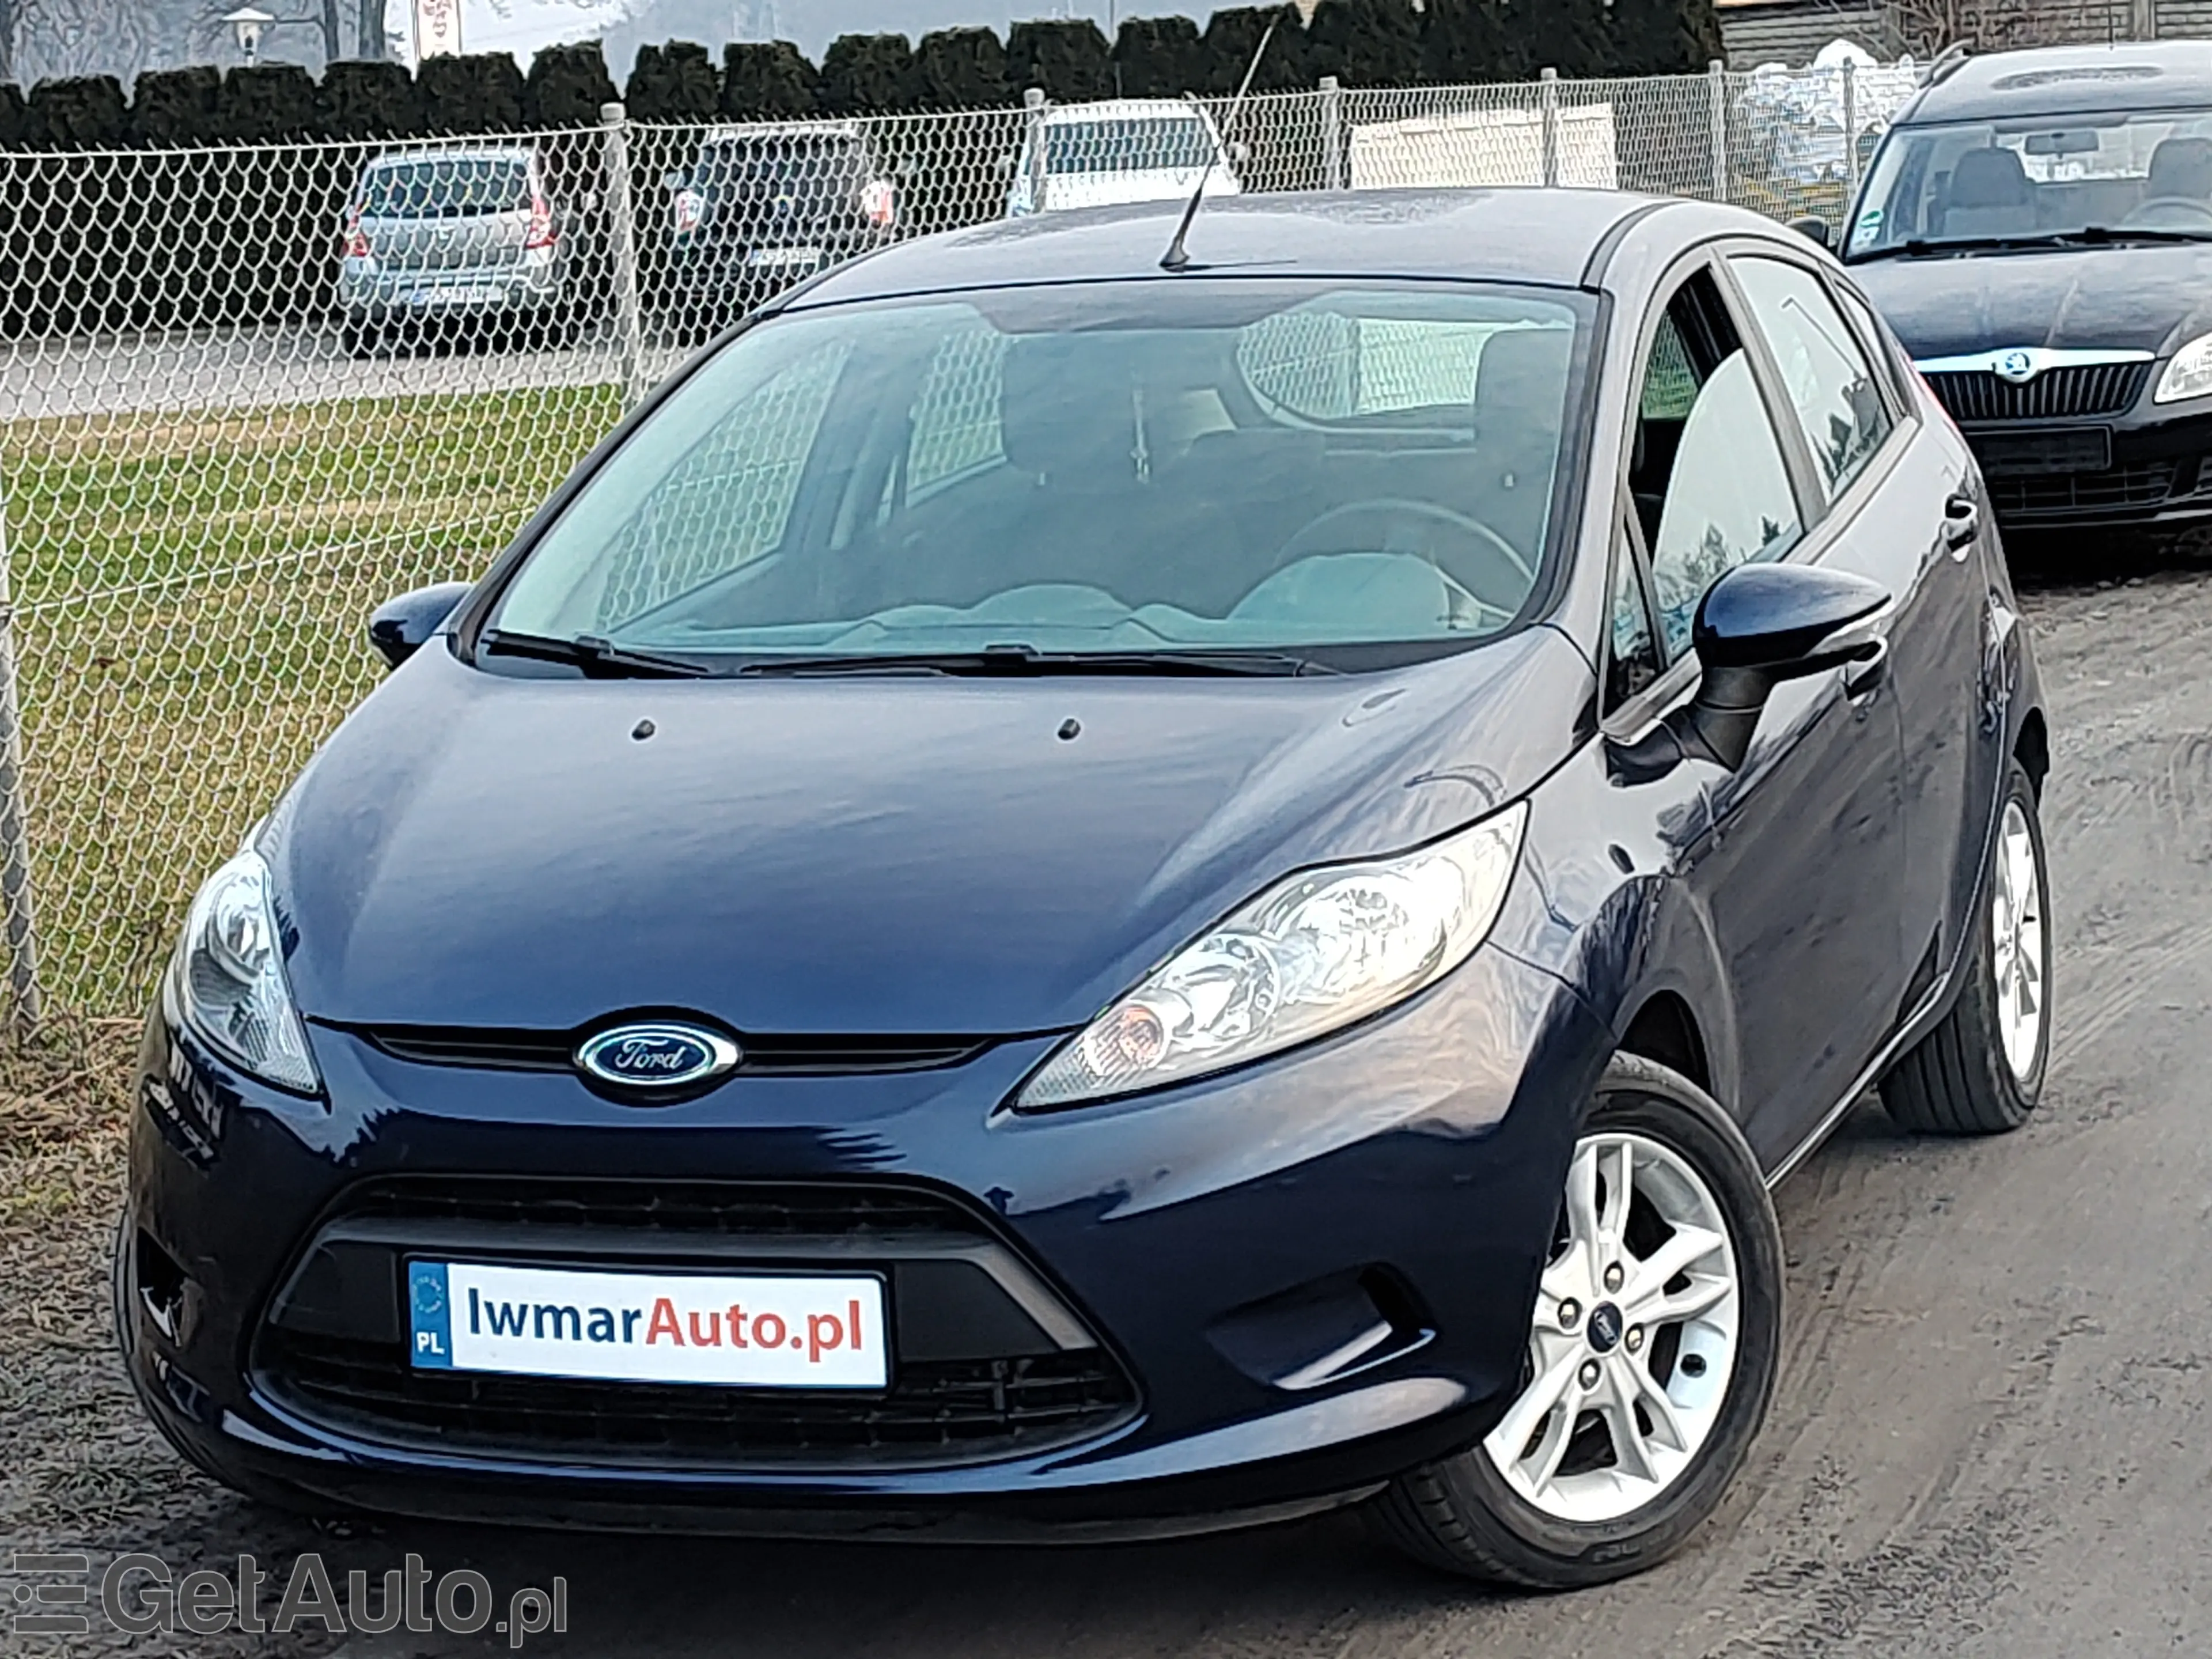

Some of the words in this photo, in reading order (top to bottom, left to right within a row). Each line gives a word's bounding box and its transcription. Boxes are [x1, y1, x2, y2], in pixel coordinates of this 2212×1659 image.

[614, 1038, 687, 1069] Ford
[468, 1287, 863, 1363] IwmarAuto.pl
[416, 1331, 445, 1355] PL
